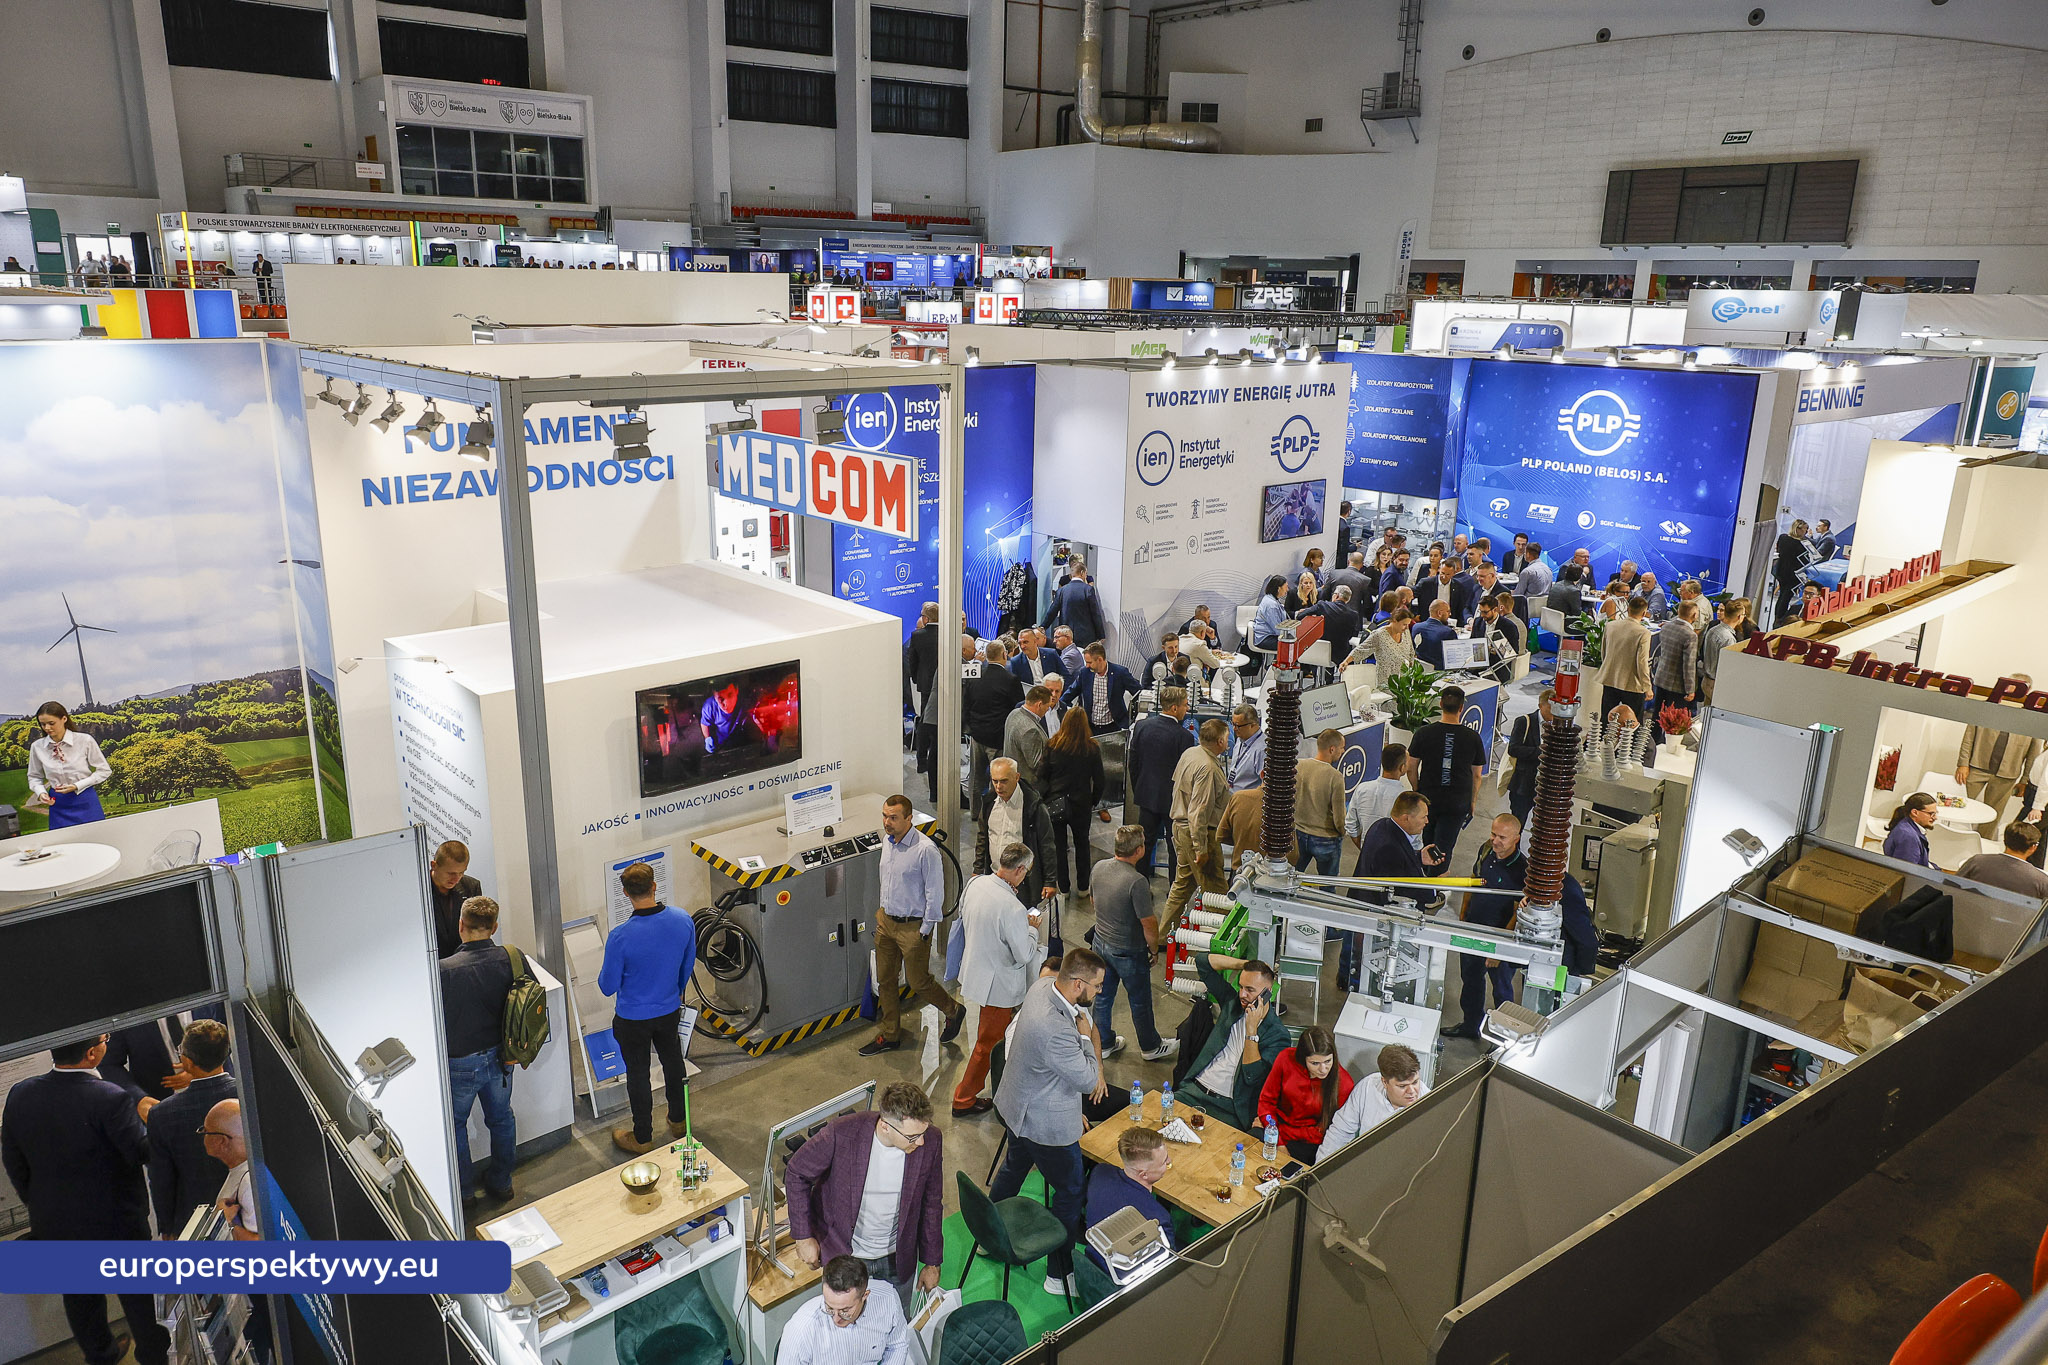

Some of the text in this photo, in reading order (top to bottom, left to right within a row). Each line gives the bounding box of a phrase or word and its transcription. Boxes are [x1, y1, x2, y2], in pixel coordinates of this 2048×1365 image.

[449, 104, 487, 114] Bielsko-Biała
[537, 112, 571, 121] Bielsko-Biała
[197, 218, 402, 233] POLSKIE STOWARZYSZENIE BRANŻY ELEKTROENERGETYCZNEJ
[433, 226, 461, 234] VIMAP
[1184, 294, 1208, 303] zenon
[1722, 303, 1779, 315] Sonel
[932, 314, 957, 324] EP&M
[1131, 340, 1167, 357] WAGO
[1366, 379, 1434, 391] IZOLATORY KOMPOZYTOWE
[1146, 382, 1336, 407] TWORZYMY ENERGIĘ JUTRA
[1798, 384, 1865, 413] BENNING
[856, 406, 887, 429] ien
[1364, 405, 1414, 416] IZOLATORY SZKLANE
[1577, 412, 1622, 435] PLP
[1180, 437, 1221, 454] Instytut
[1282, 435, 1311, 454] PLP
[1362, 431, 1427, 444] IZOLATORY PORCELANOWE
[1143, 446, 1168, 467] ien
[1179, 450, 1235, 469] Energetyki
[1359, 456, 1399, 467] ZESTAWY OPGW
[1521, 457, 1669, 484] PLP POLAND (BELOS) S.A.
[722, 436, 906, 534] MEDCOM
[1615, 522, 1642, 532] Insulator
[1670, 537, 1688, 545] POWER
[1743, 630, 1841, 670] KPB
[1846, 650, 1975, 699] Intra
[965, 669, 977, 677] 16
[1343, 760, 1361, 778] ien
[582, 813, 630, 836] JAKOŚĆ
[759, 760, 843, 791] DOŚWIADCZENIE
